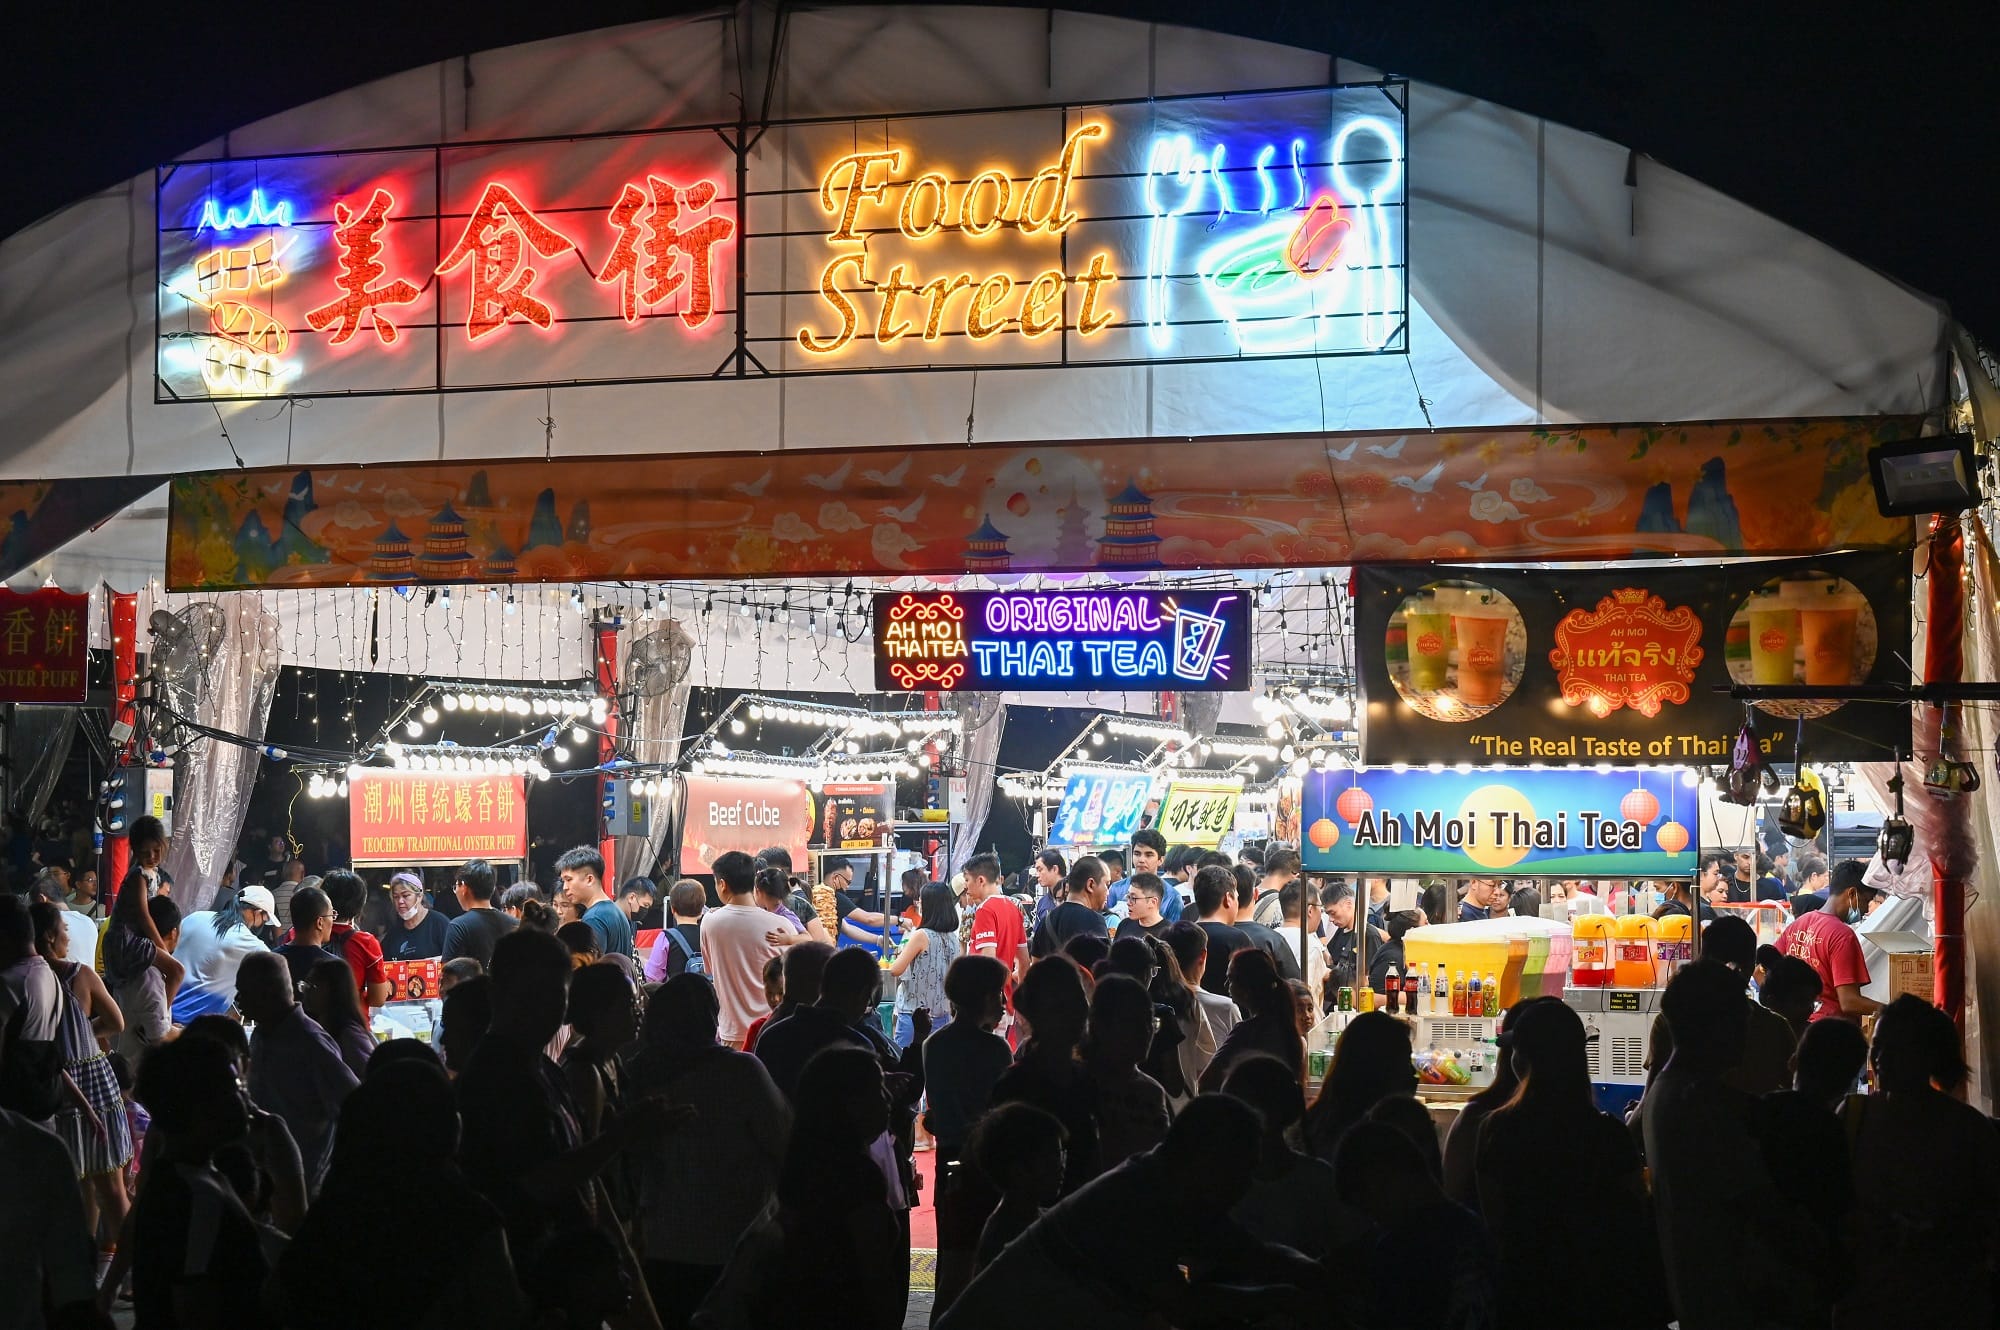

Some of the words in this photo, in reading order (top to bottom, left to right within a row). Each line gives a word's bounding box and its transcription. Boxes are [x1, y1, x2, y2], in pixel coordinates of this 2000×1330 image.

[821, 124, 1103, 243] Food
[304, 174, 736, 346] 美食街
[797, 253, 1117, 355] Street
[985, 596, 1162, 633] ORIGINAL
[887, 621, 915, 639] AH
[1610, 628, 1624, 637] AH
[1627, 628, 1647, 637] MOI
[971, 641, 1073, 676] THAI
[1082, 640, 1167, 676] TEA
[1577, 641, 1676, 667] แท้จริง
[41, 669, 79, 687] PUFF
[1604, 673, 1626, 682] THAI
[1629, 673, 1647, 682] TEA
[1529, 735, 1577, 756] Real
[1582, 737, 1641, 756] Taste
[1648, 735, 1672, 756] of
[1678, 735, 1727, 755] Thai
[709, 799, 741, 826] Beef
[745, 799, 780, 826] Cube
[1354, 809, 1400, 848] Ah
[1413, 809, 1476, 848] Moi
[1489, 810, 1567, 849] Thai
[1579, 811, 1642, 850] Tea
[362, 836, 405, 853] TEOCHEW
[407, 836, 463, 852] TRADITIONAL
[464, 836, 495, 851] OYSTER
[497, 834, 516, 850] PUFF
